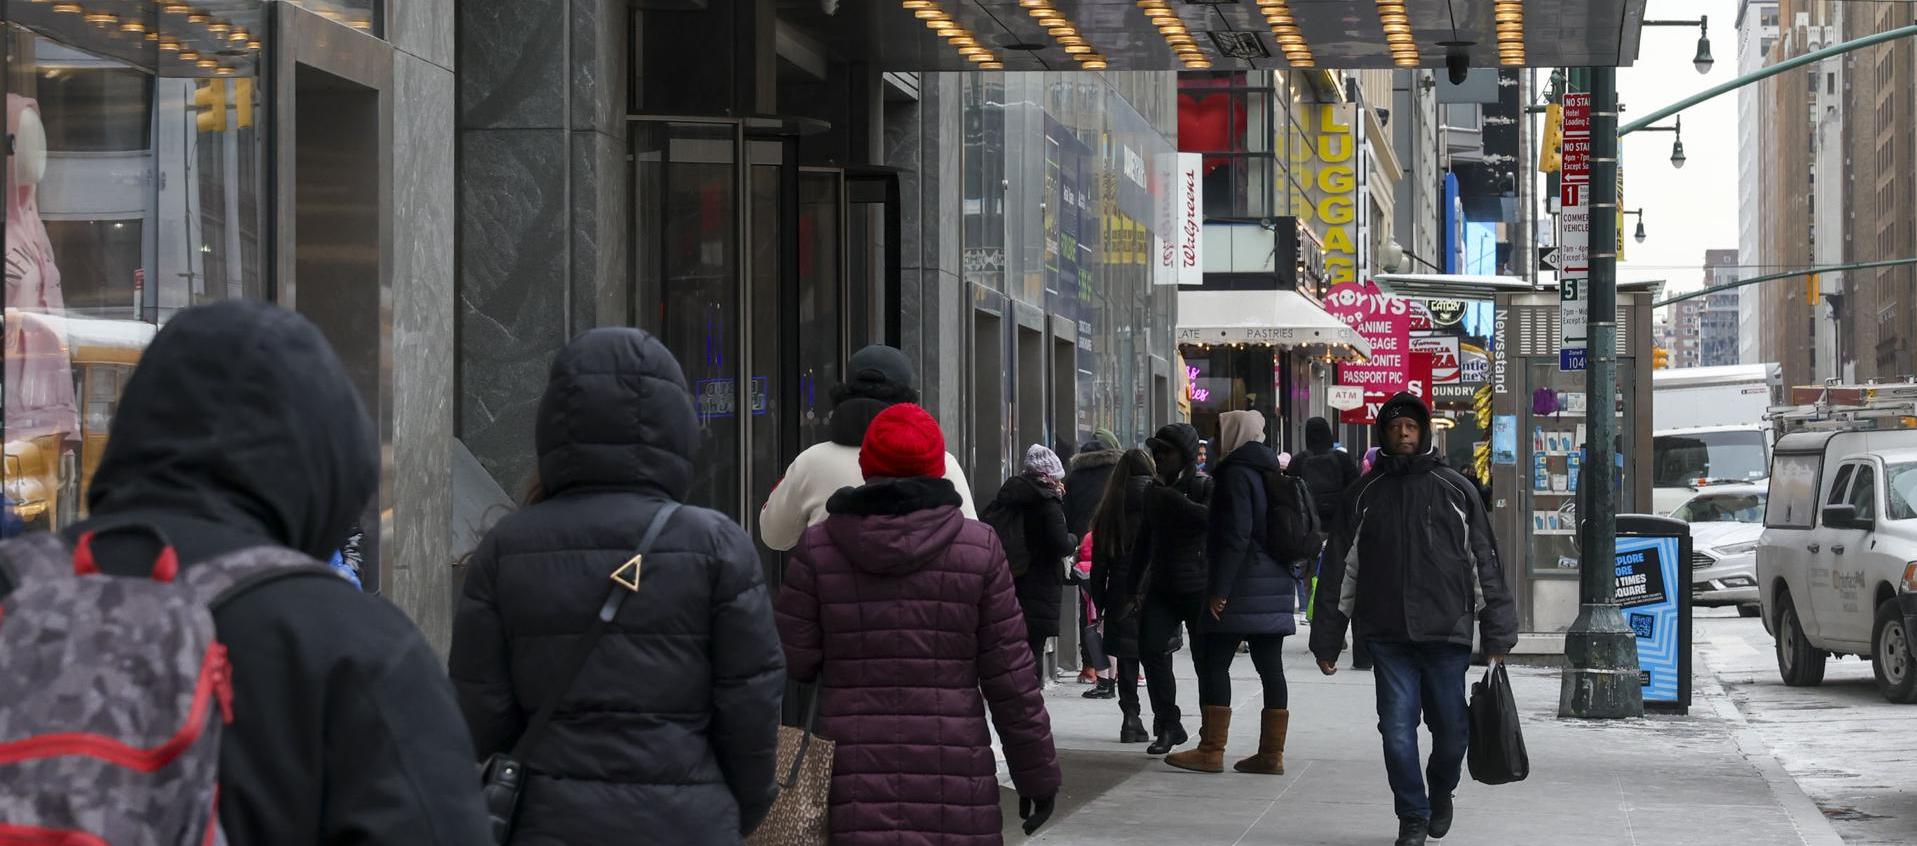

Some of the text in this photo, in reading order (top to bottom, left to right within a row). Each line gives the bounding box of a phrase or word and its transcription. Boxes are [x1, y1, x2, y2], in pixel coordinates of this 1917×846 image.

[1565, 97, 1590, 107] NO STA
[1565, 109, 1580, 117] Hotel
[1565, 118, 1585, 126] Loading
[1564, 143, 1590, 152] NO STA
[1563, 163, 1581, 171] Except
[1316, 104, 1355, 285] LUGGAG
[1567, 185, 1573, 205] 1
[1182, 169, 1199, 268] Walgreens
[1563, 223, 1589, 233] VEHICLE
[1563, 253, 1581, 262] Except
[1564, 280, 1574, 300] 5
[1357, 321, 1392, 333] ANIME
[1563, 317, 1581, 325] Except
[1178, 328, 1200, 339] ATE
[1247, 328, 1294, 339] PASTRIES
[1367, 337, 1398, 350] GAGE
[1495, 309, 1508, 394] Newsstand
[1462, 358, 1488, 371] ntie
[1569, 357, 1587, 369] 104
[1343, 370, 1404, 384] PASSPORT PIC
[1407, 379, 1423, 398] S
[1432, 386, 1476, 396] OUNDRY
[1335, 391, 1357, 400] ATM
[1365, 402, 1384, 420] N
[1616, 552, 1645, 566] PLORE
[1615, 565, 1633, 577] ORE
[1620, 573, 1647, 587] TIMES
[1615, 584, 1647, 598] QUARE
